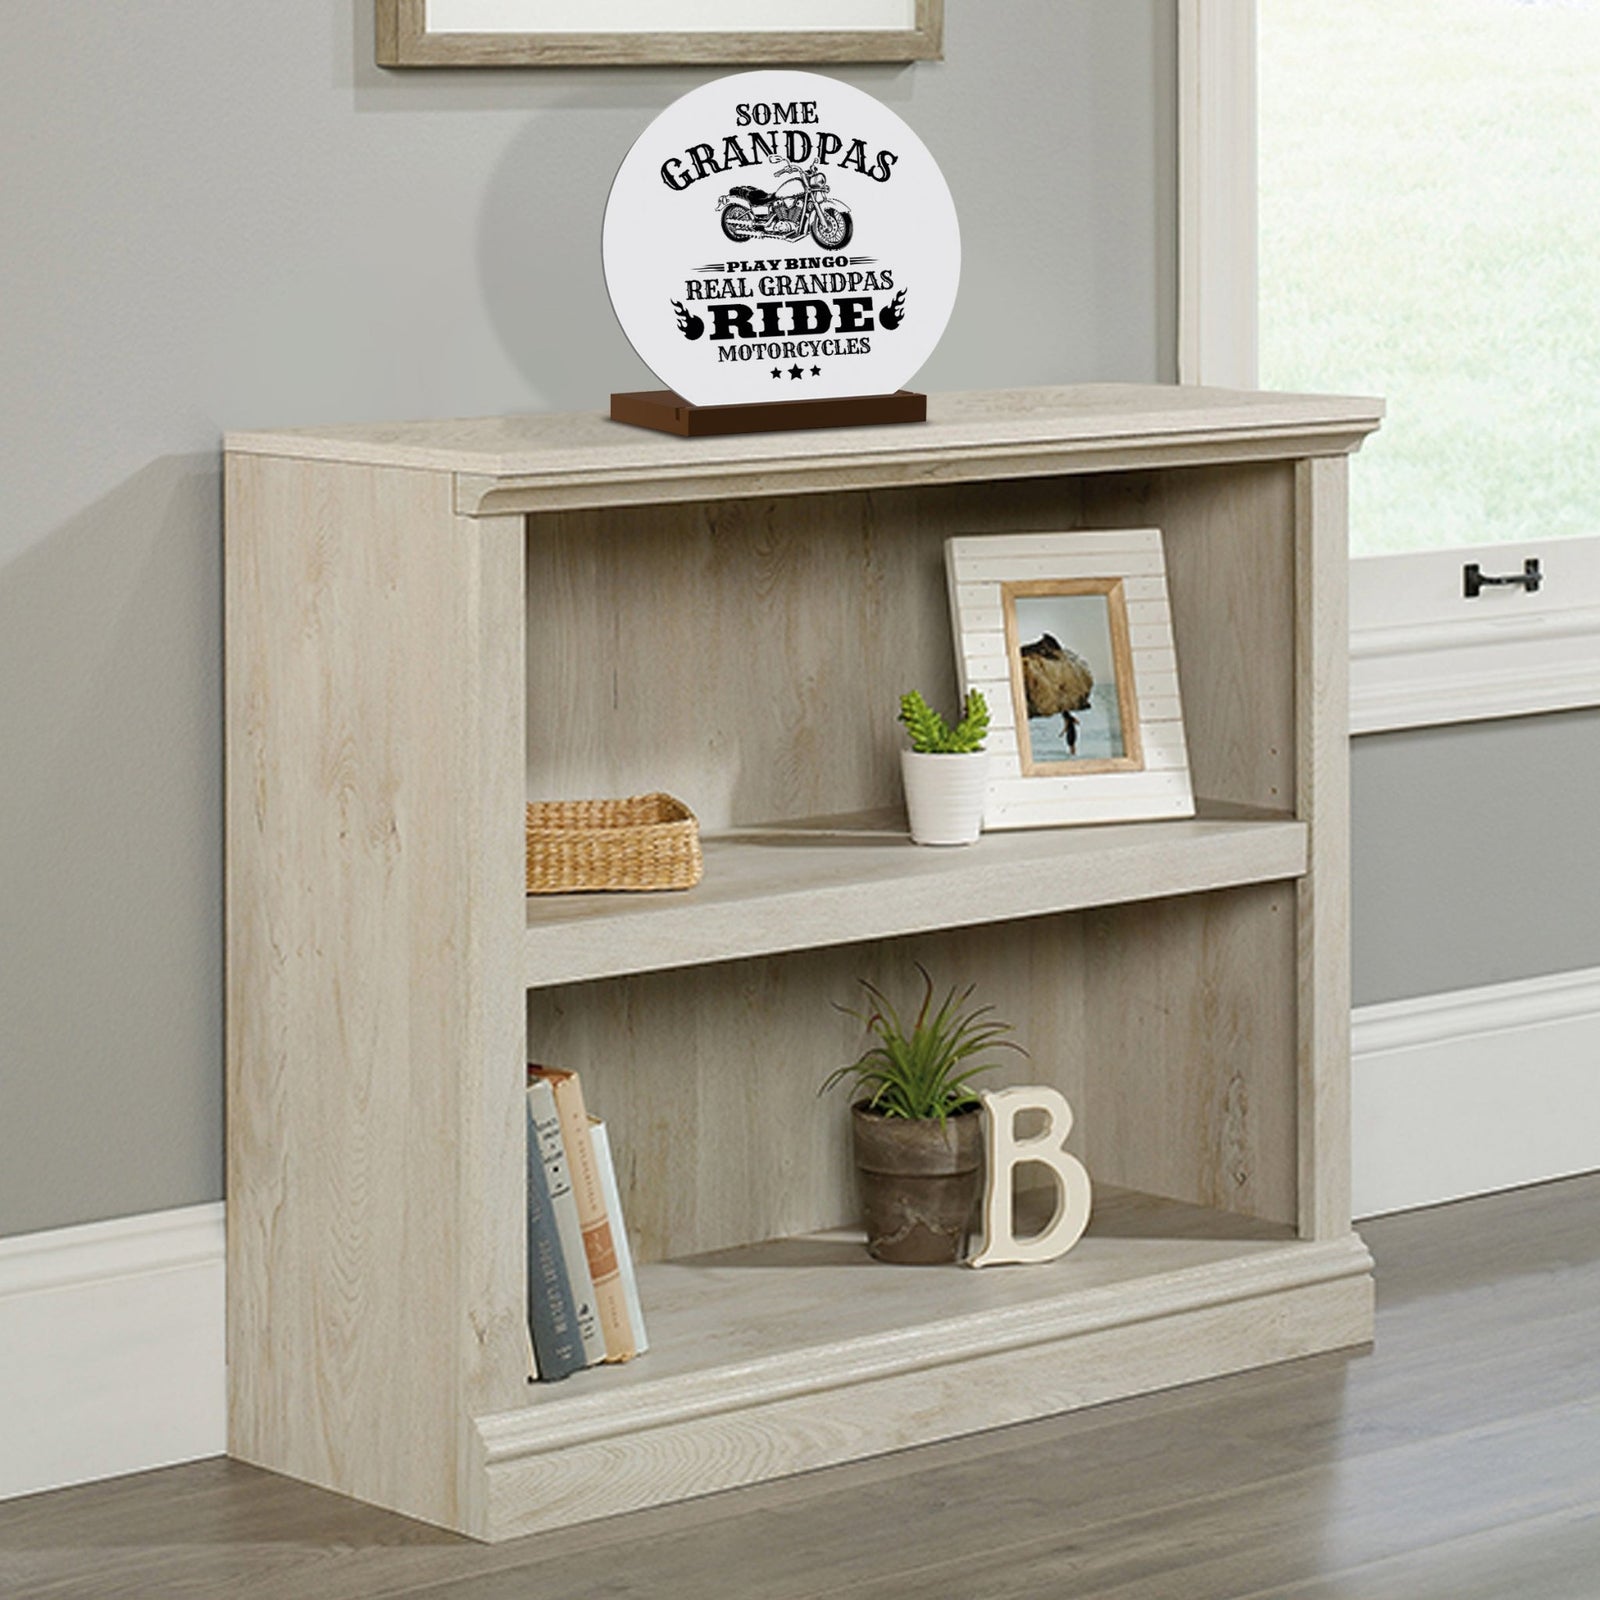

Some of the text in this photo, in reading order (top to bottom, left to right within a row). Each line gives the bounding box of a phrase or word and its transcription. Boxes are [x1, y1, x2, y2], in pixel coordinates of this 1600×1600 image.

[736, 101, 819, 126] SOME
[661, 130, 898, 191] GRANDPAS
[726, 256, 848, 272] PLAY BINGO
[685, 270, 893, 300] REAL GRANDPAS
[709, 298, 875, 340] RIDE
[718, 338, 870, 362] MOTORCYCLES
